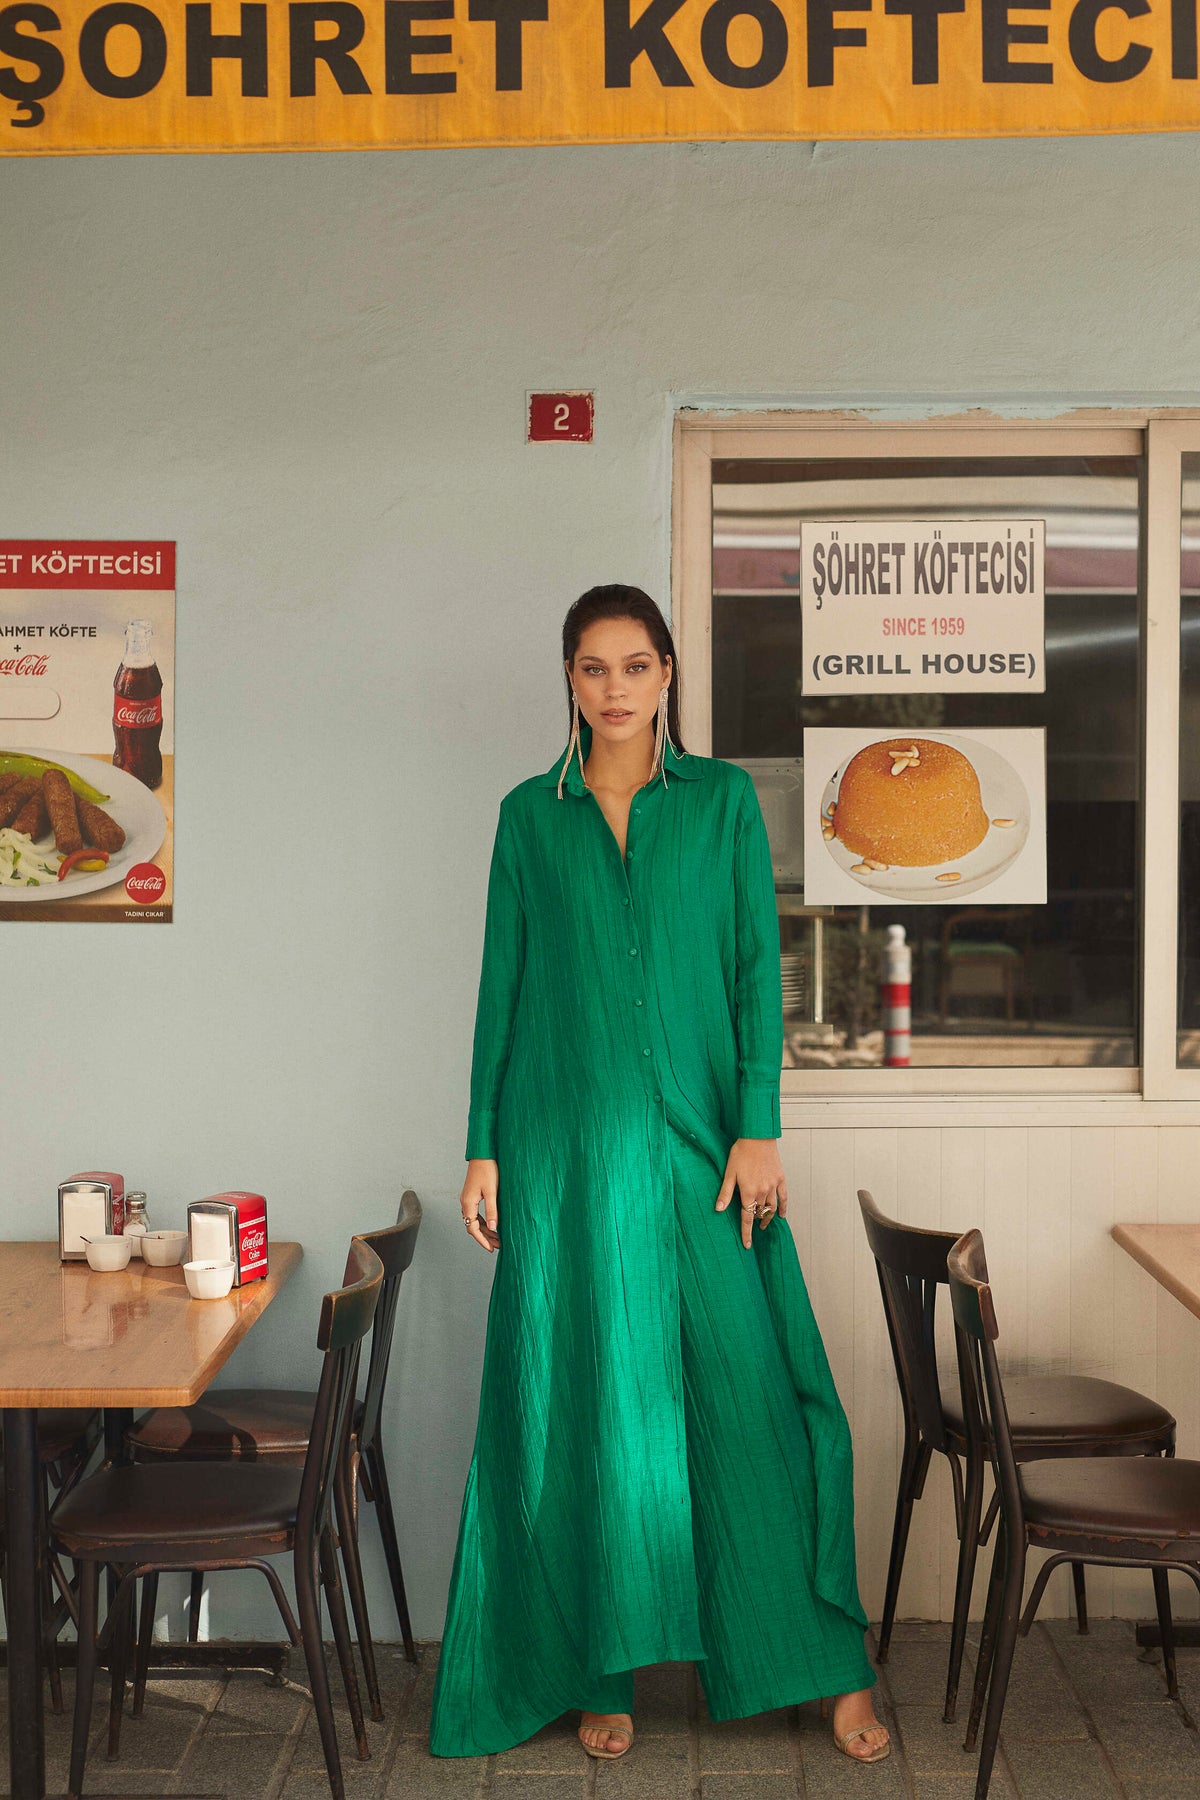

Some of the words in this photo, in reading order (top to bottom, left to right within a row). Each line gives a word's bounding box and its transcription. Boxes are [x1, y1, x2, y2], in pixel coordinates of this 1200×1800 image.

[554, 403, 569, 431] 2
[31, 550, 162, 575] KÖFTECİSİ
[812, 531, 906, 611] ŞÖHRET
[914, 528, 1035, 595] KÖFTECİSİ
[49, 624, 97, 638] KÖFTE
[882, 617, 926, 636] SINCE
[931, 617, 965, 636] 1959
[812, 654, 911, 681] (GRILL
[922, 653, 1036, 679] HOUSE)
